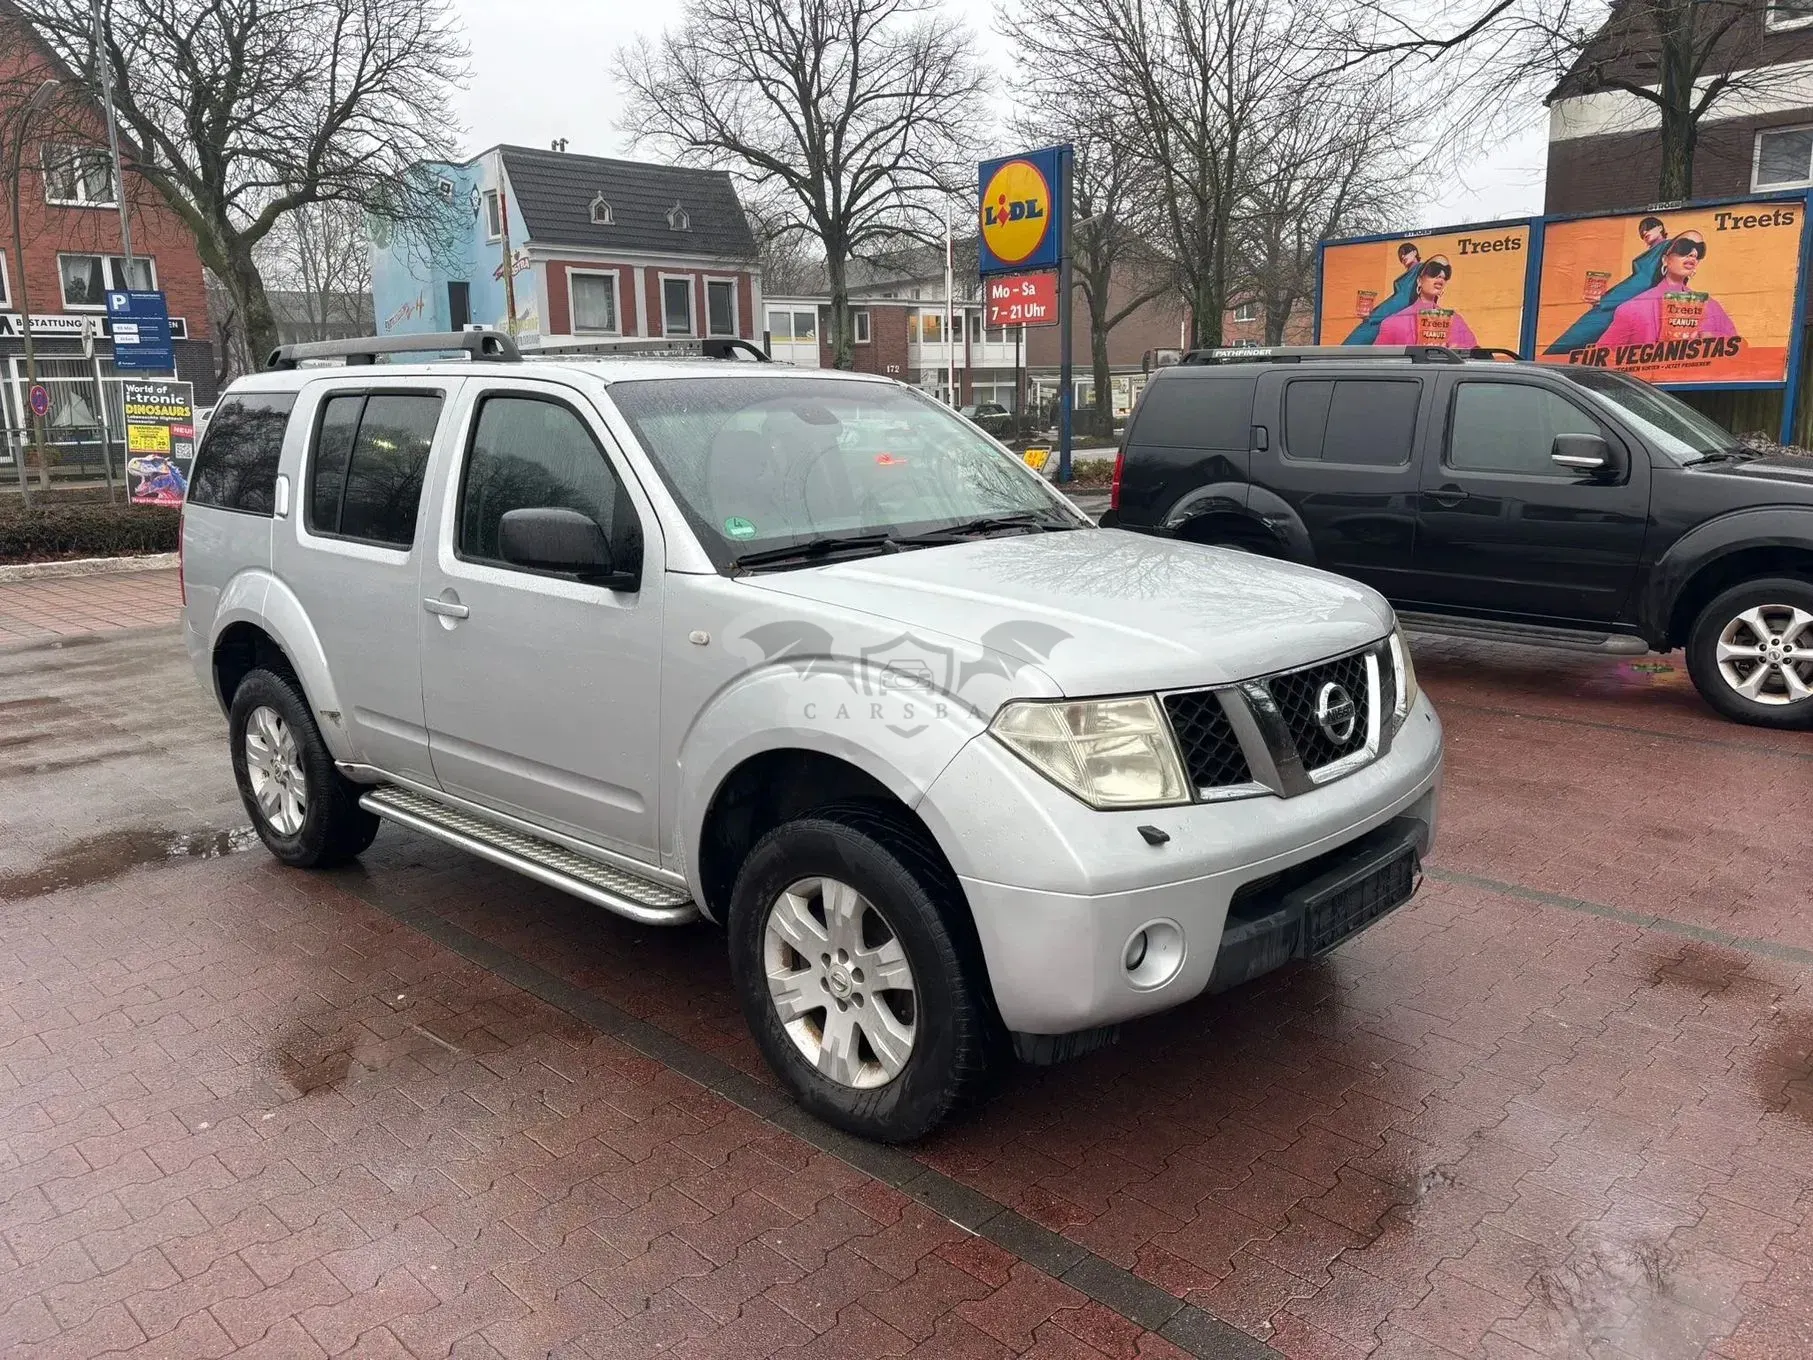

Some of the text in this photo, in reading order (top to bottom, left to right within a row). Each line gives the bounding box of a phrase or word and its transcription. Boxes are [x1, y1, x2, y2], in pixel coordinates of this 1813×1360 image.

[1715, 209, 1794, 231] Treets
[1458, 235, 1521, 255] Treets
[992, 285, 1010, 298] Mo
[1022, 282, 1036, 296] Sa
[992, 307, 999, 320] 7
[1010, 305, 1021, 319] 21
[1025, 303, 1045, 318] Uhr
[1667, 304, 1702, 315] Treets
[16, 318, 96, 328] BSTATTUNGN
[1669, 318, 1699, 328] PEANUTS
[1215, 349, 1272, 357] PATHFINDER
[1569, 336, 1741, 366] FÜR VEGANISTAS
[887, 365, 900, 373] 172
[126, 384, 153, 393] World
[126, 392, 184, 404] i-tronic
[125, 404, 191, 416] DINOSAURS
[173, 426, 193, 435] NEU!
